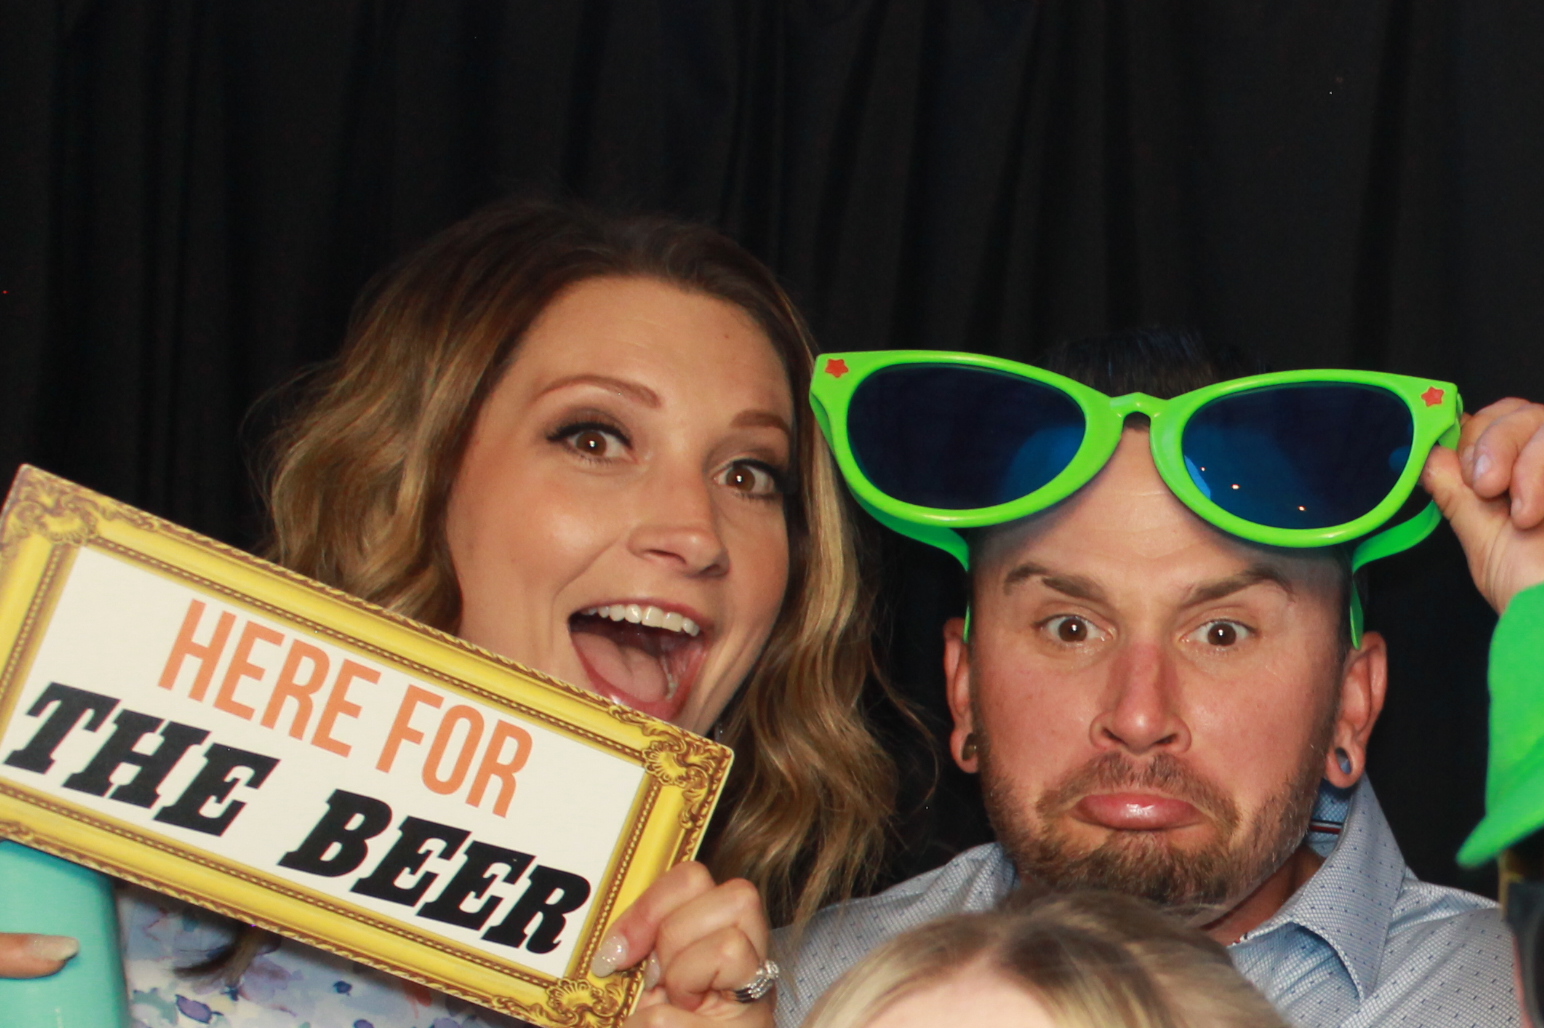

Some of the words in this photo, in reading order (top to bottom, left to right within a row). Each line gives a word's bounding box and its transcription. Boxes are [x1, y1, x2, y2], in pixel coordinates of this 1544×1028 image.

[4, 682, 281, 837] THE
[278, 788, 592, 955] BEER
[158, 598, 381, 758] HERE
[375, 683, 533, 818] FOR
